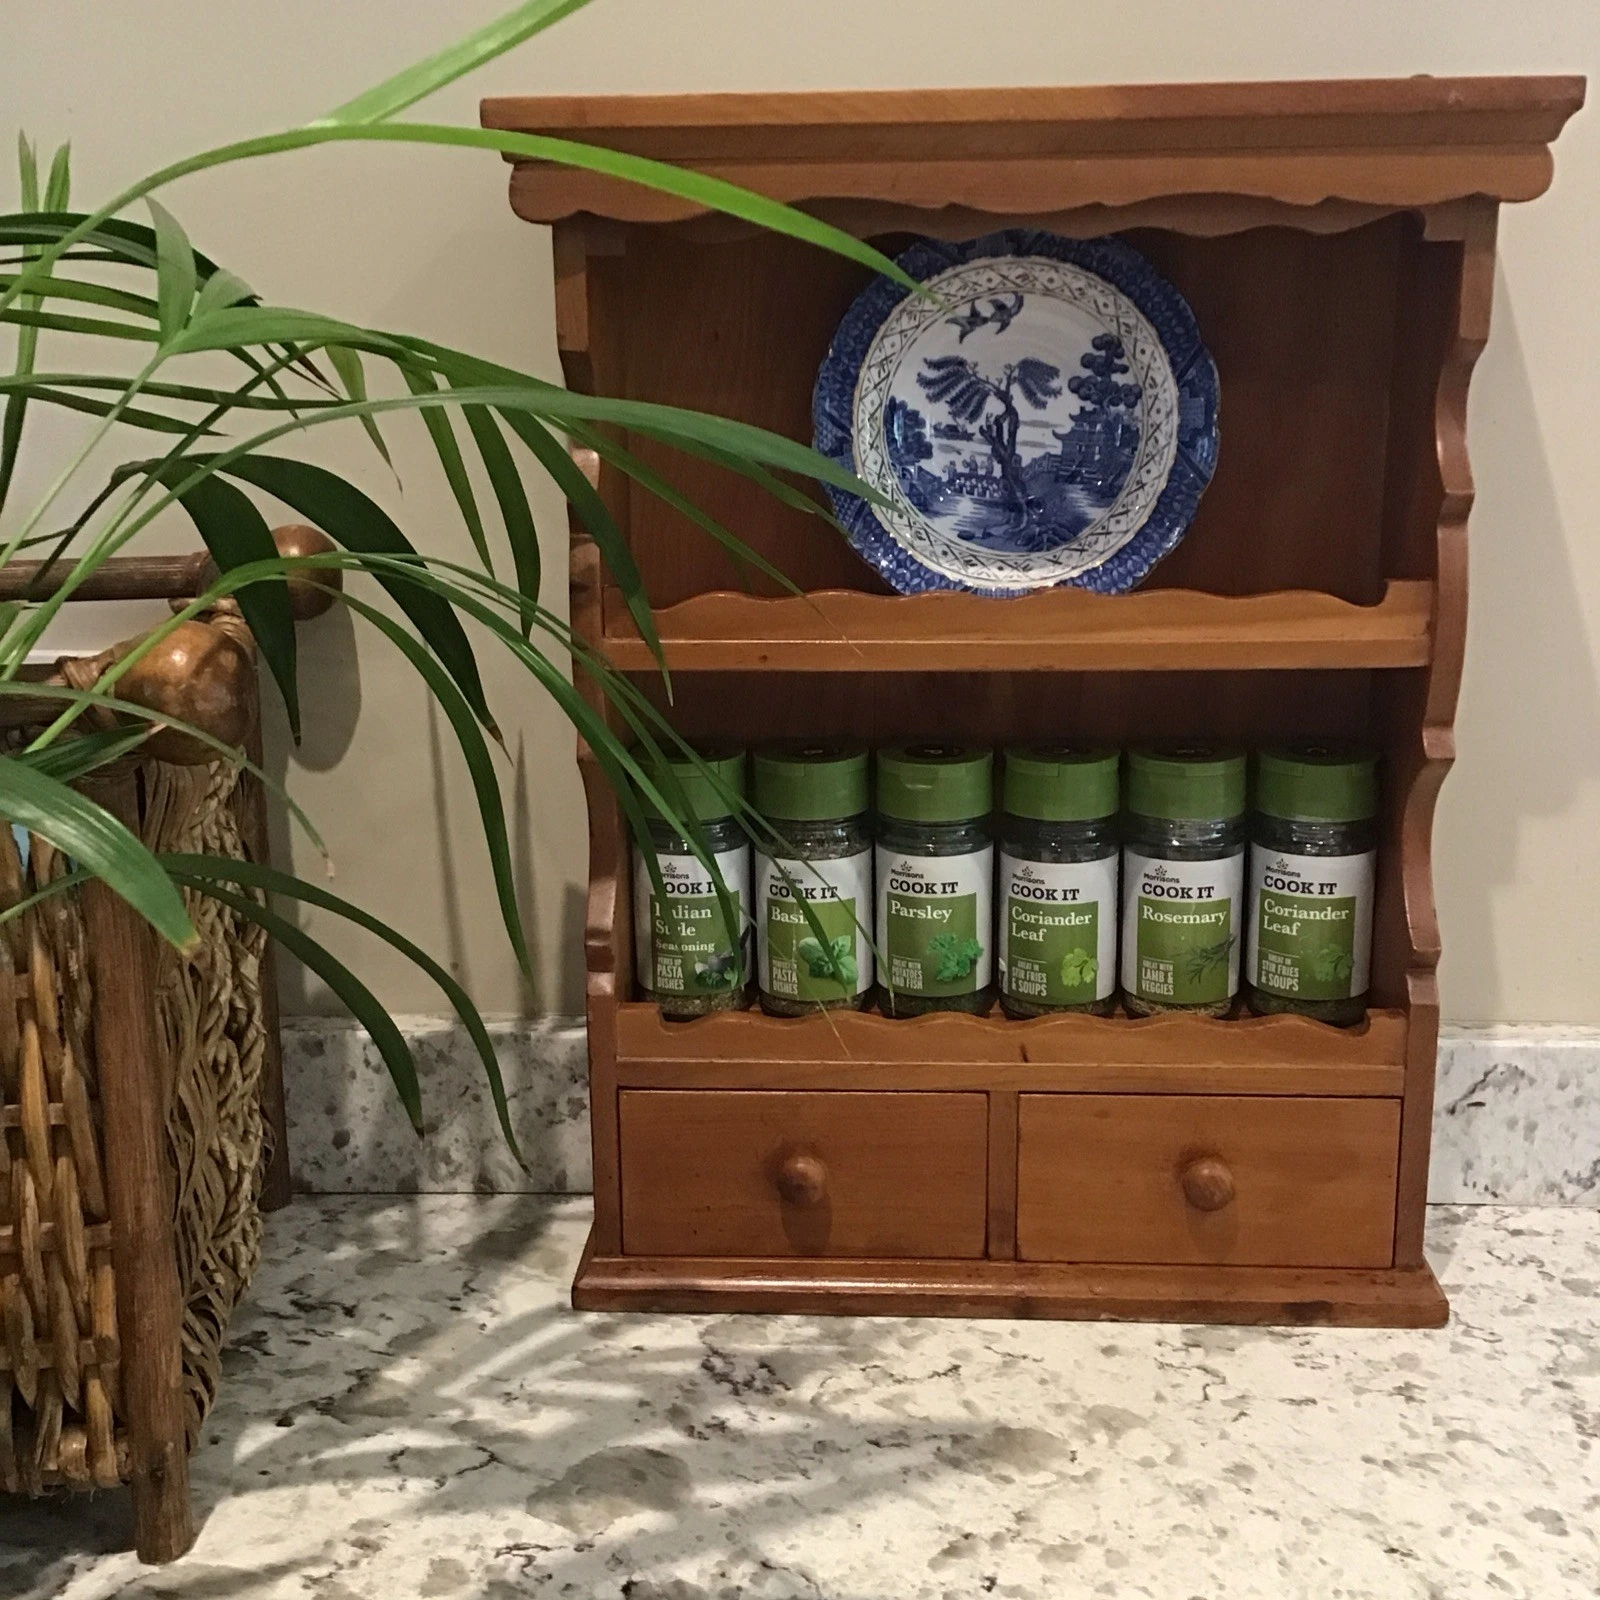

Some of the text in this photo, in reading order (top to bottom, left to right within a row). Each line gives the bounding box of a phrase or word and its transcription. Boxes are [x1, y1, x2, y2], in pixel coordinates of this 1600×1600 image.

[891, 868, 924, 879] Morrisons
[1012, 873, 1045, 885] Morrisons
[1144, 872, 1180, 883] Morrisons
[1265, 865, 1301, 878] Morrisons
[664, 881, 703, 895] OOK
[770, 884, 817, 899] COK
[890, 878, 958, 894] COOK IT
[1011, 883, 1079, 901] COOK IT
[1142, 882, 1214, 899] COOK IT
[1264, 875, 1337, 895] COOK IT
[771, 906, 808, 925] Basi
[890, 900, 952, 923] Parsley
[1012, 905, 1092, 926] Coriander
[1142, 905, 1227, 926] Rosemary
[1264, 898, 1349, 921] Coriander
[1011, 923, 1047, 941] Leaf
[1263, 915, 1301, 935] Leaf
[657, 963, 683, 979] PASTA
[773, 966, 798, 983] PASTA
[1026, 970, 1047, 983] FRIES
[1142, 967, 1164, 982] LAMB
[1277, 964, 1299, 978] FRIES
[657, 976, 684, 991] DISHES
[906, 979, 922, 990] FISH
[1018, 979, 1047, 996] SOUPS
[1141, 980, 1174, 996] VEGGIES
[1268, 973, 1299, 992] SOUPS
